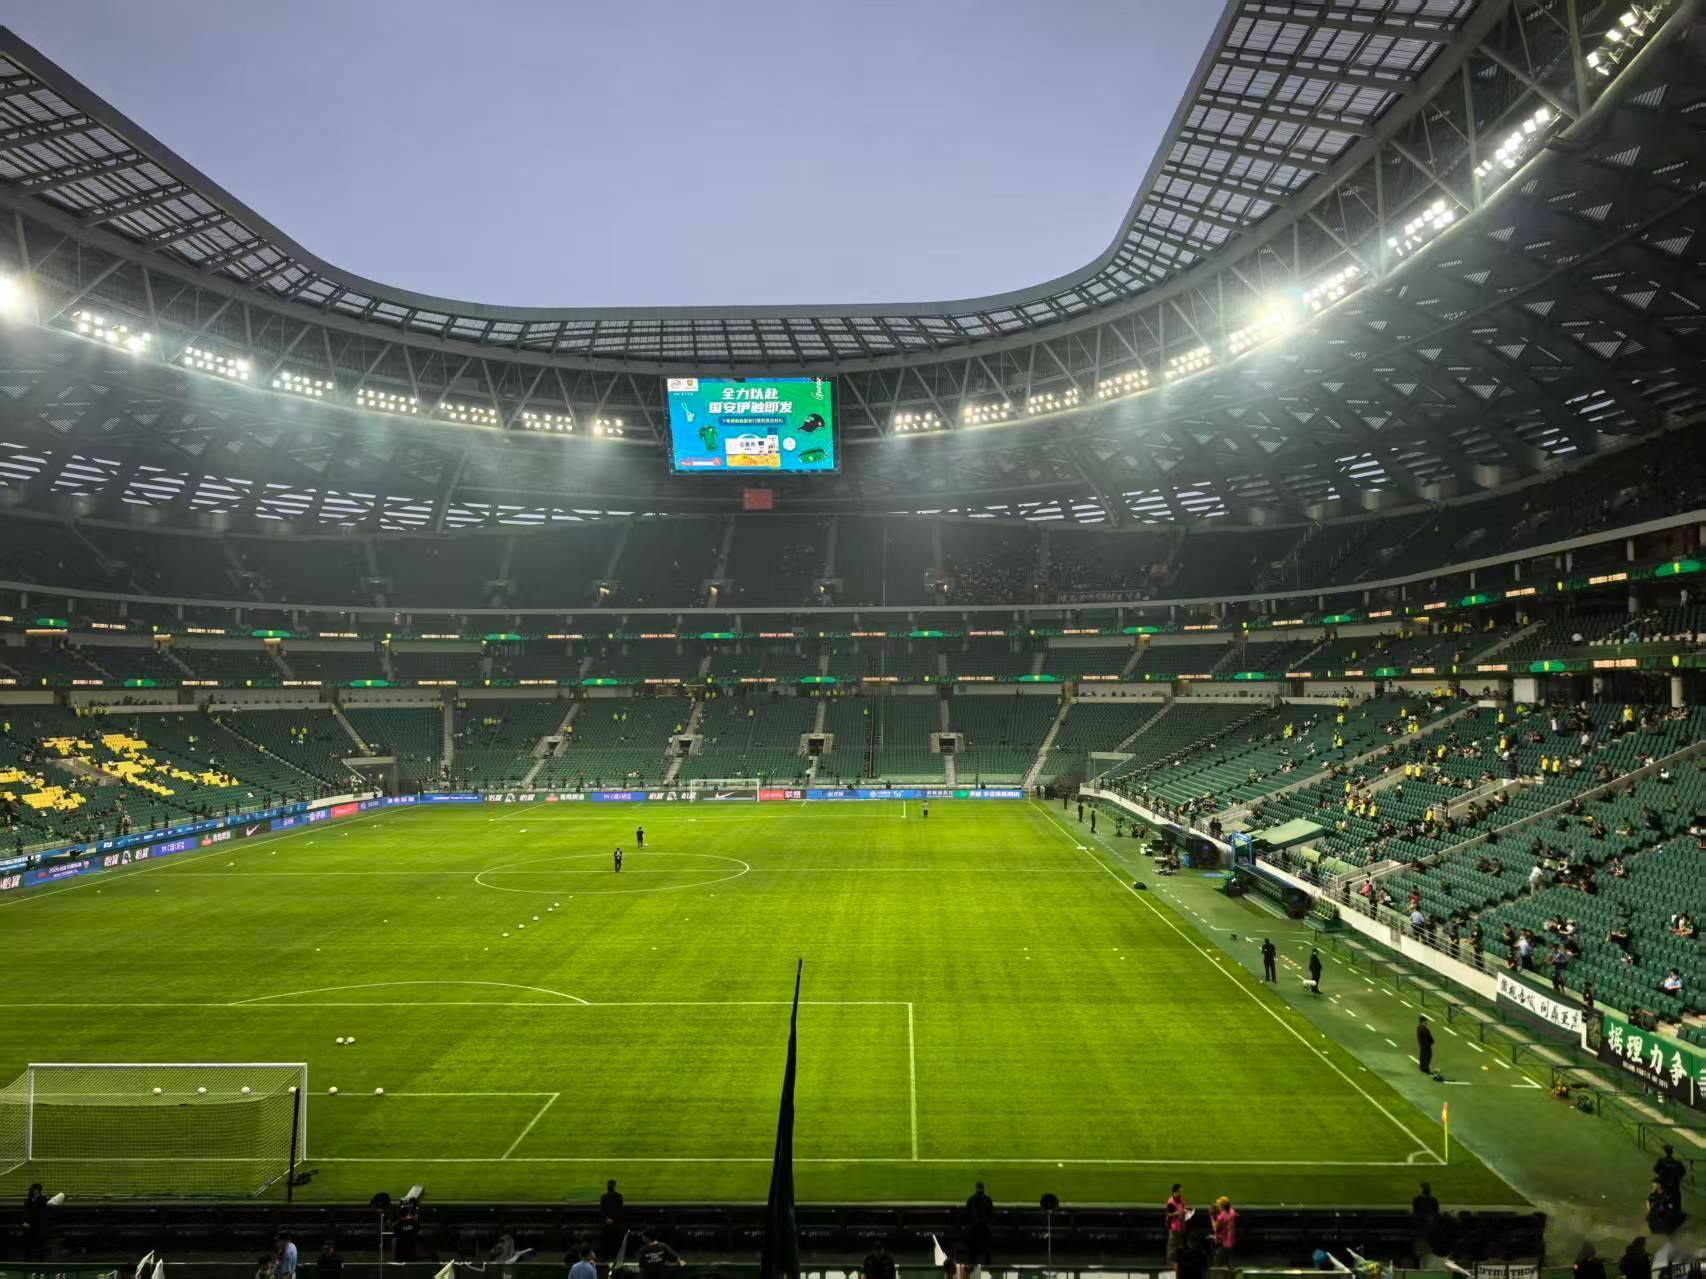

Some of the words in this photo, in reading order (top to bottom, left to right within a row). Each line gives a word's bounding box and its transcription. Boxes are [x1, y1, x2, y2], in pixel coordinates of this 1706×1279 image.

[721, 387, 779, 400] 全力以赴
[1607, 1022, 1688, 1087] 据理力争
